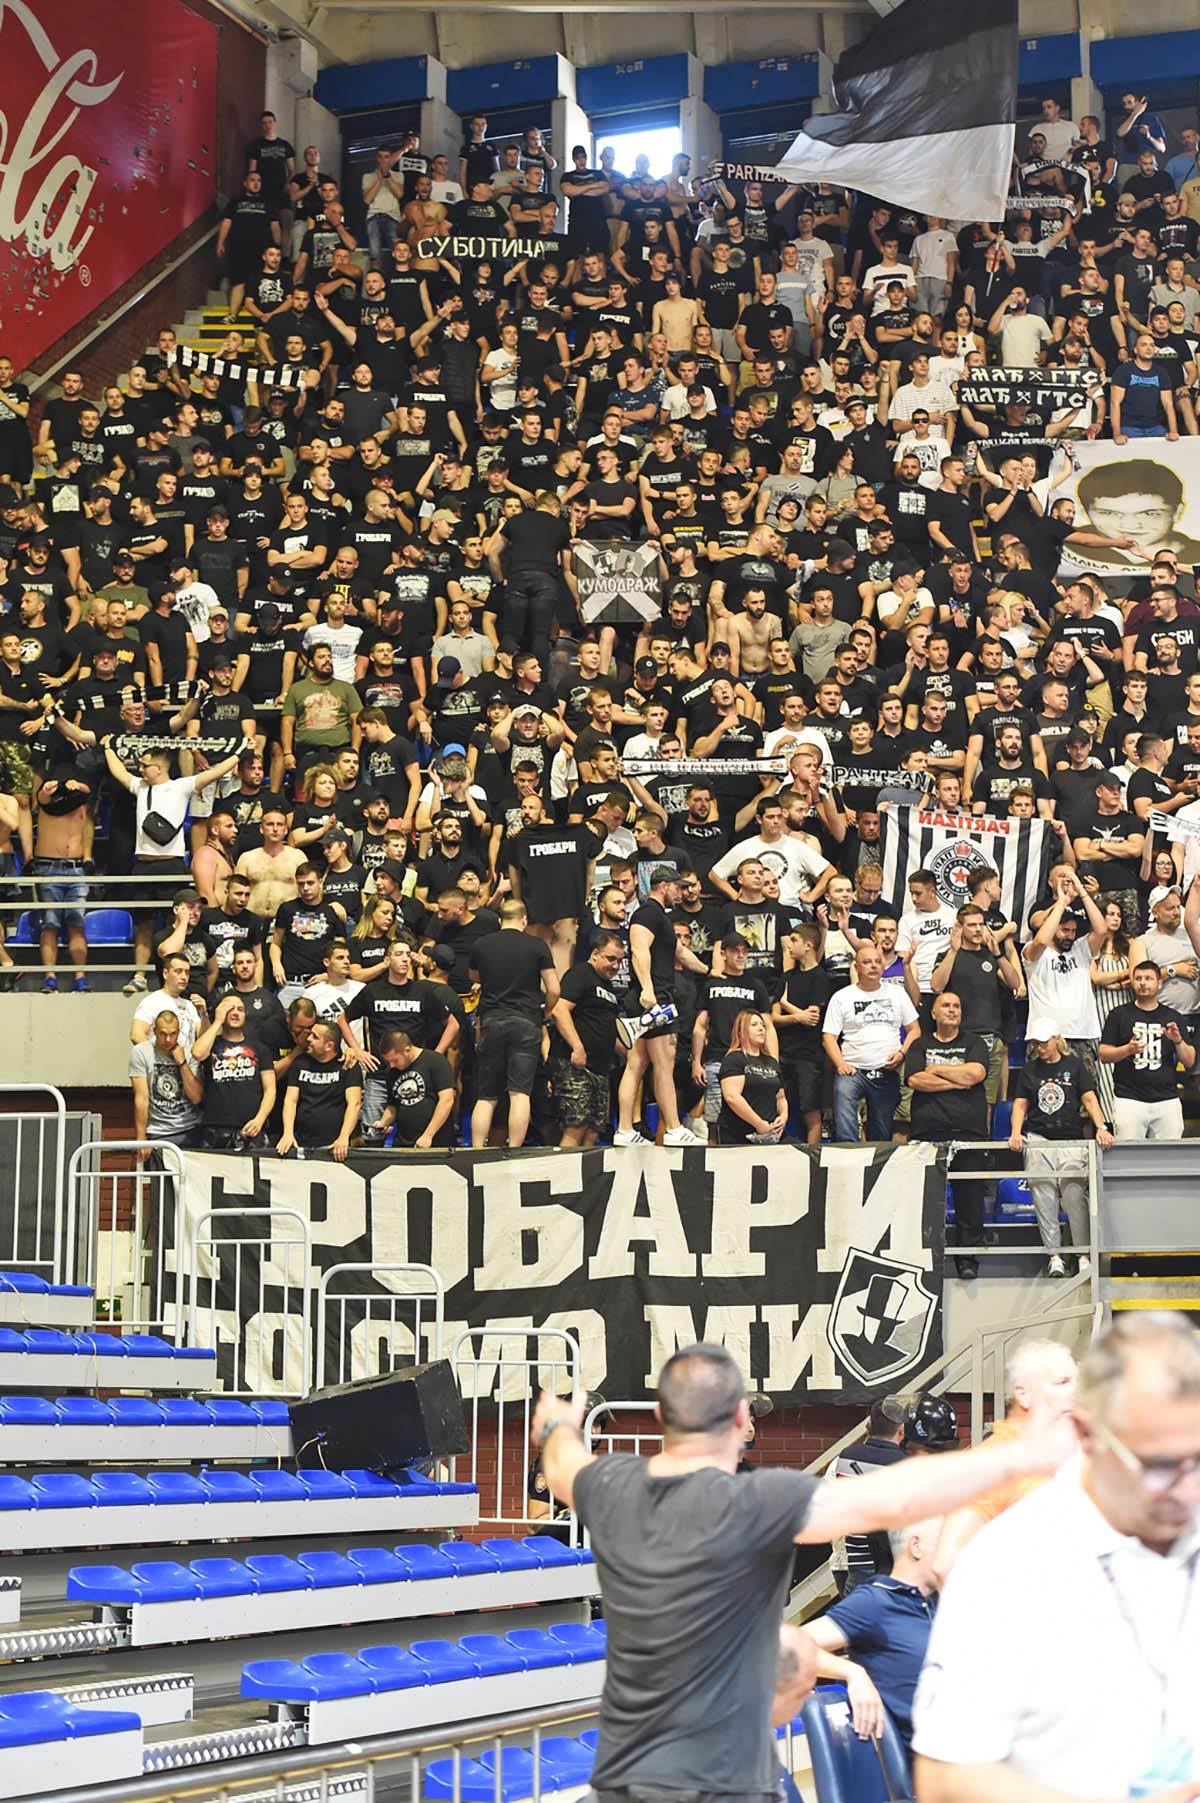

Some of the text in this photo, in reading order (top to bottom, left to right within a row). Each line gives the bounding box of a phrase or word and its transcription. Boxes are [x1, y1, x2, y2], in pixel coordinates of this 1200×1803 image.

[727, 163, 788, 183] PARTIZA
[417, 237, 545, 259] СУБОТИЦА
[1051, 370, 1098, 385] ГТС
[1037, 390, 1085, 408] ГТС
[577, 577, 660, 594] КУМОДРАЖ
[529, 841, 577, 856] ГРОБАРИ
[924, 919, 941, 929] JUST
[709, 986, 755, 1001] ГРОБАРИ
[374, 1000, 421, 1013] ГРОБАРИ
[298, 1069, 340, 1085] ГРОБАРИ
[164, 1145, 938, 1294] ГРОБАРИ
[644, 1303, 842, 1392] МИ
